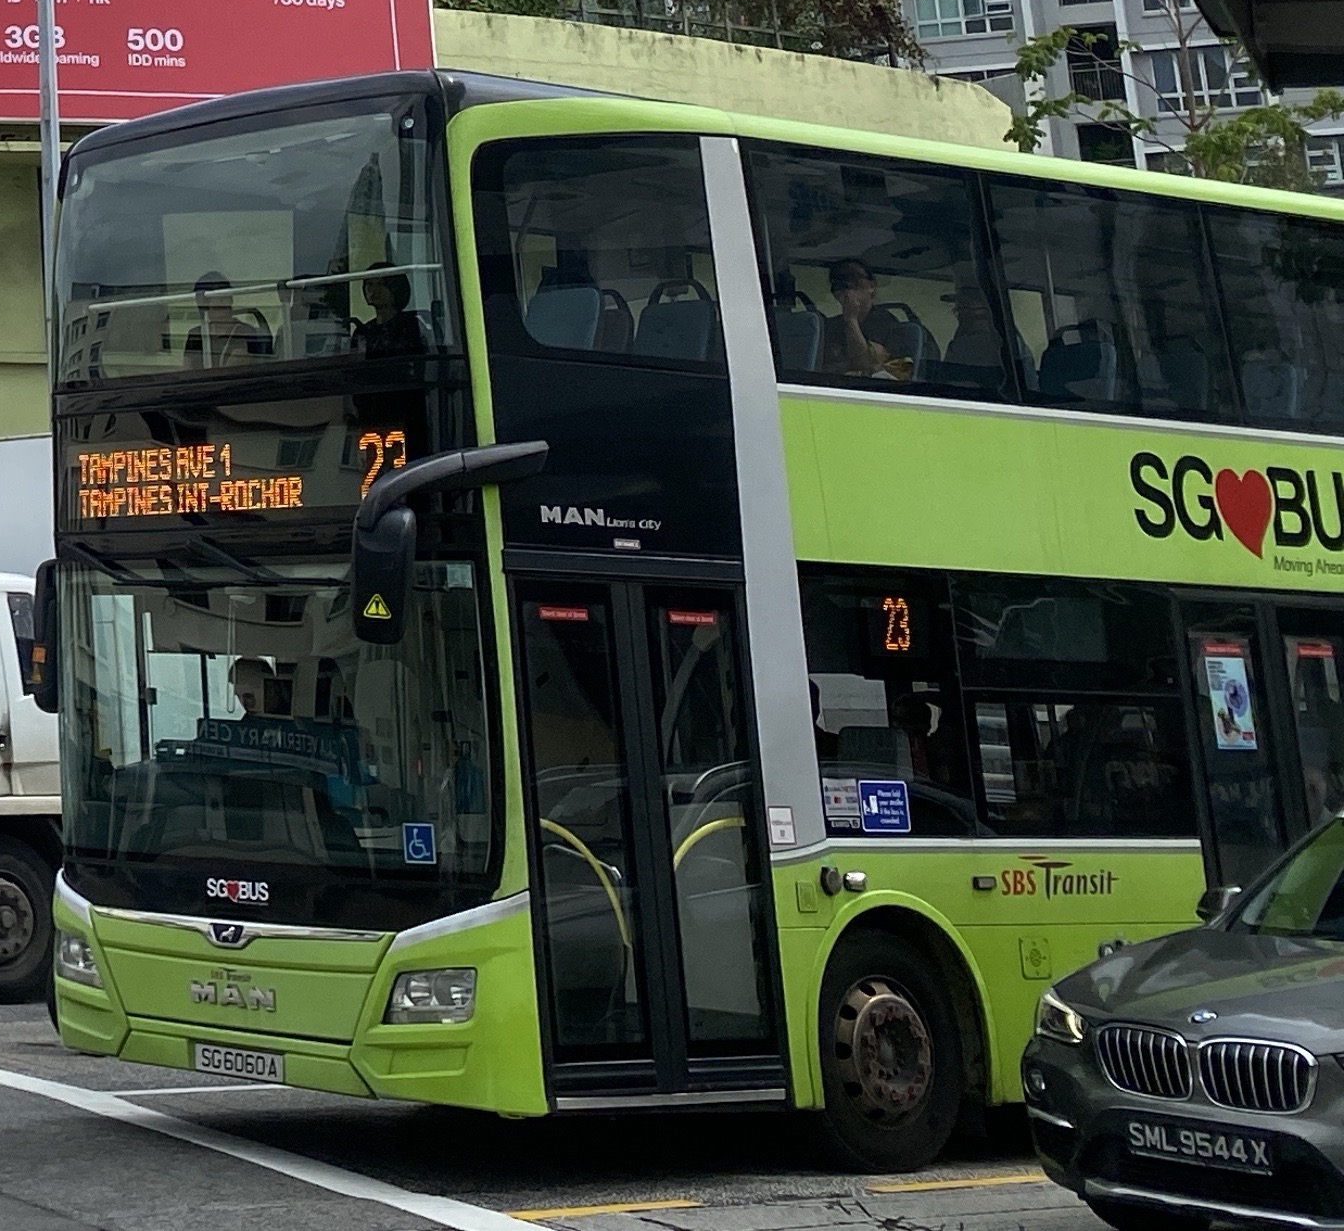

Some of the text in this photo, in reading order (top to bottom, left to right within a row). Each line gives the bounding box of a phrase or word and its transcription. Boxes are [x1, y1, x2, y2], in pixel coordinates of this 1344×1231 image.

[127, 28, 184, 52] 500
[127, 52, 187, 68] IDD mins
[79, 443, 231, 485] TAMPINES AVE 1
[79, 485, 173, 518] TAMPINES
[540, 505, 605, 526] MAN
[1274, 555, 1313, 577] Moving
[1001, 861, 1119, 901] SBS Transit
[191, 980, 276, 1013] MAN
[201, 1048, 277, 1077] SG6060A
[1129, 1122, 1269, 1167] SML9544X
